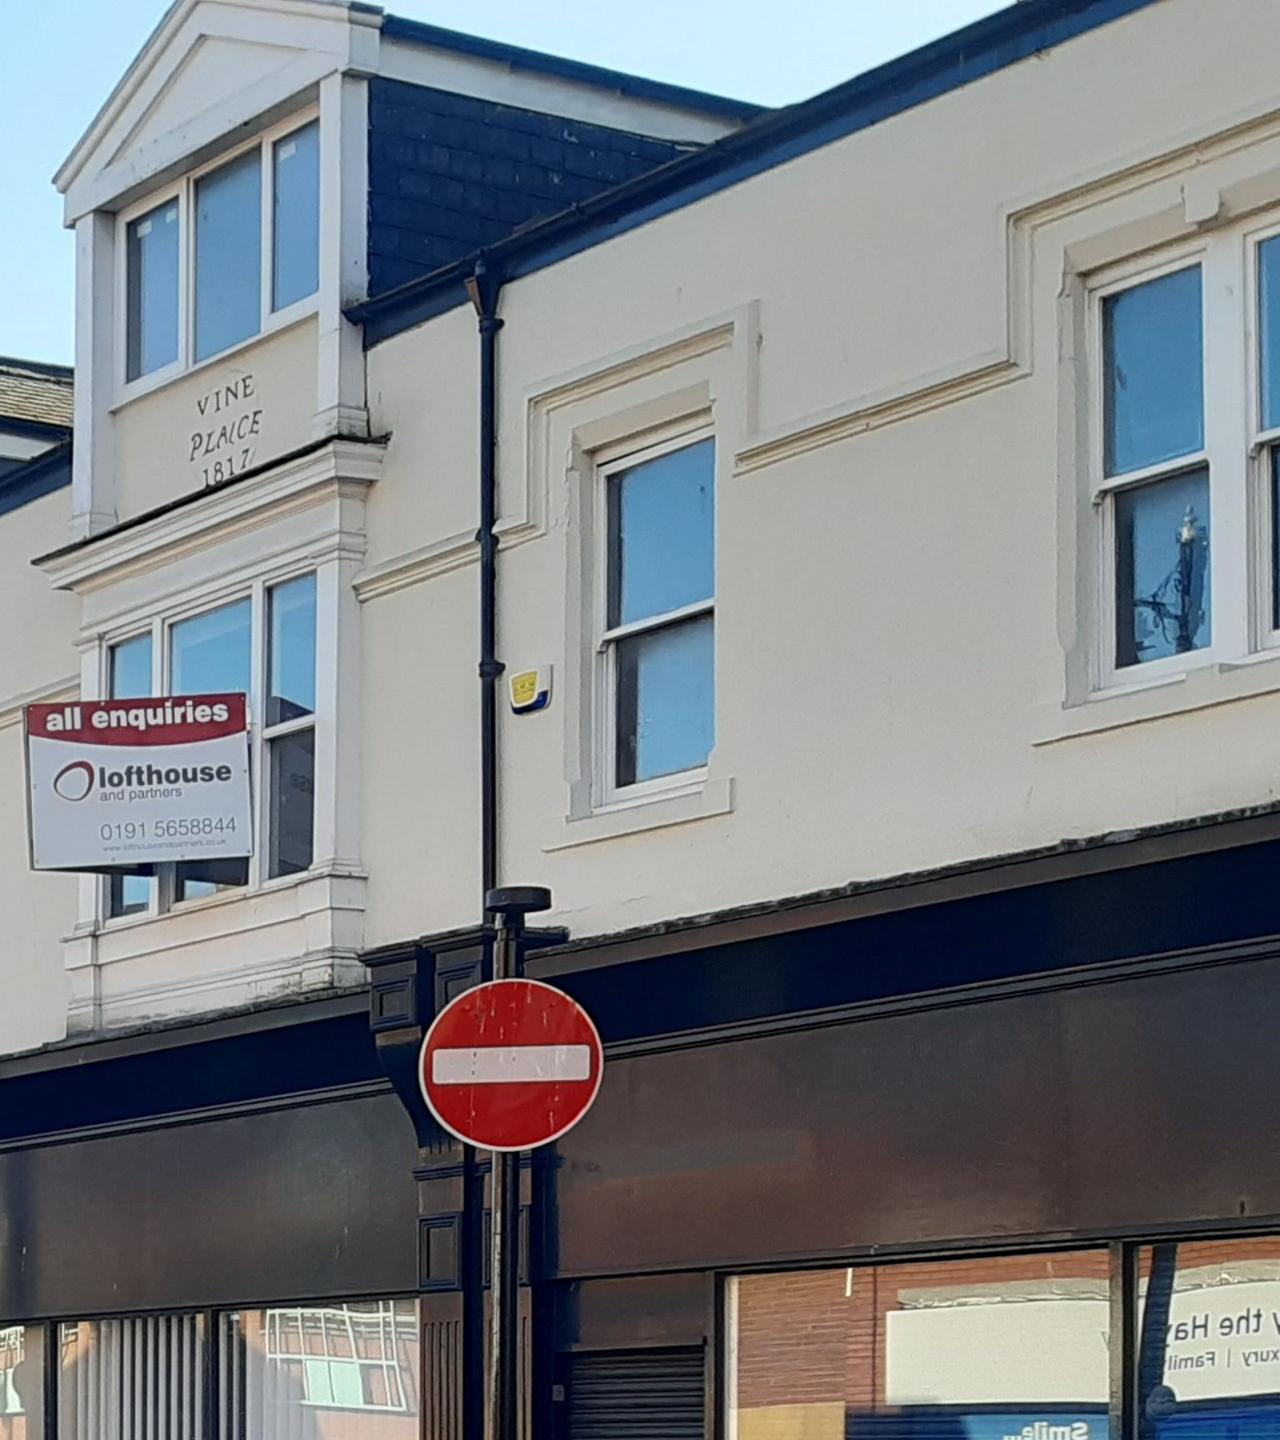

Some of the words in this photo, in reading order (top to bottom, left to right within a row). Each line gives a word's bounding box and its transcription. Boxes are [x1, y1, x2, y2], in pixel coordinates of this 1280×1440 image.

[196, 374, 255, 416] VINE
[46, 706, 82, 732] all
[91, 699, 229, 731] enquiries
[99, 763, 233, 789] lofthouse
[99, 788, 125, 801] and
[128, 786, 183, 805] partners
[100, 821, 146, 841] 0191
[154, 816, 237, 839] 5658844
